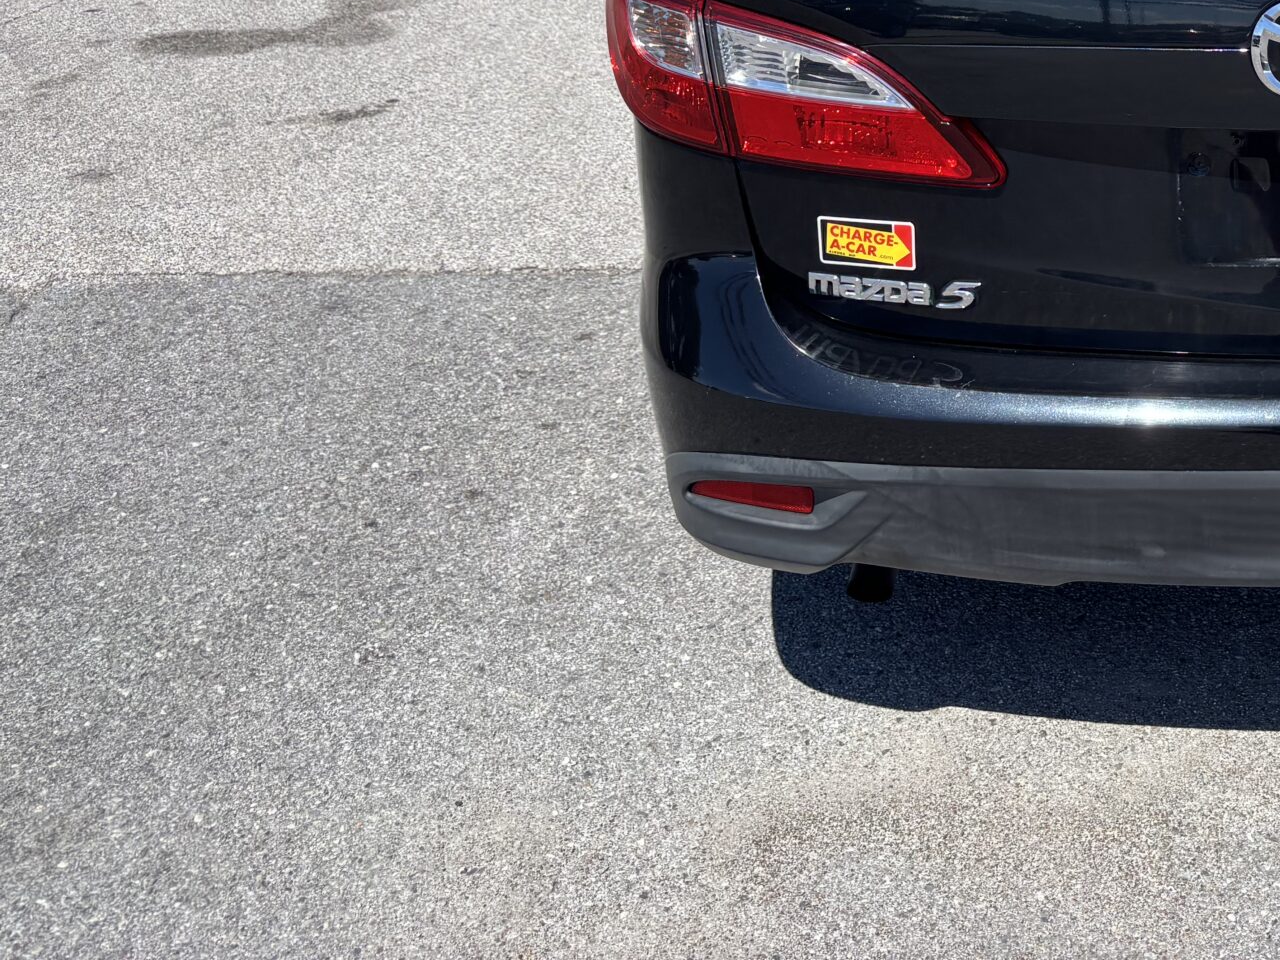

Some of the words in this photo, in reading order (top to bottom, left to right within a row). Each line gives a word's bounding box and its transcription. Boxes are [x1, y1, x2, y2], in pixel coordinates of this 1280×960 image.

[829, 225, 899, 247] CHARGE-
[829, 238, 877, 257] A-CAR
[935, 281, 982, 309] 5
